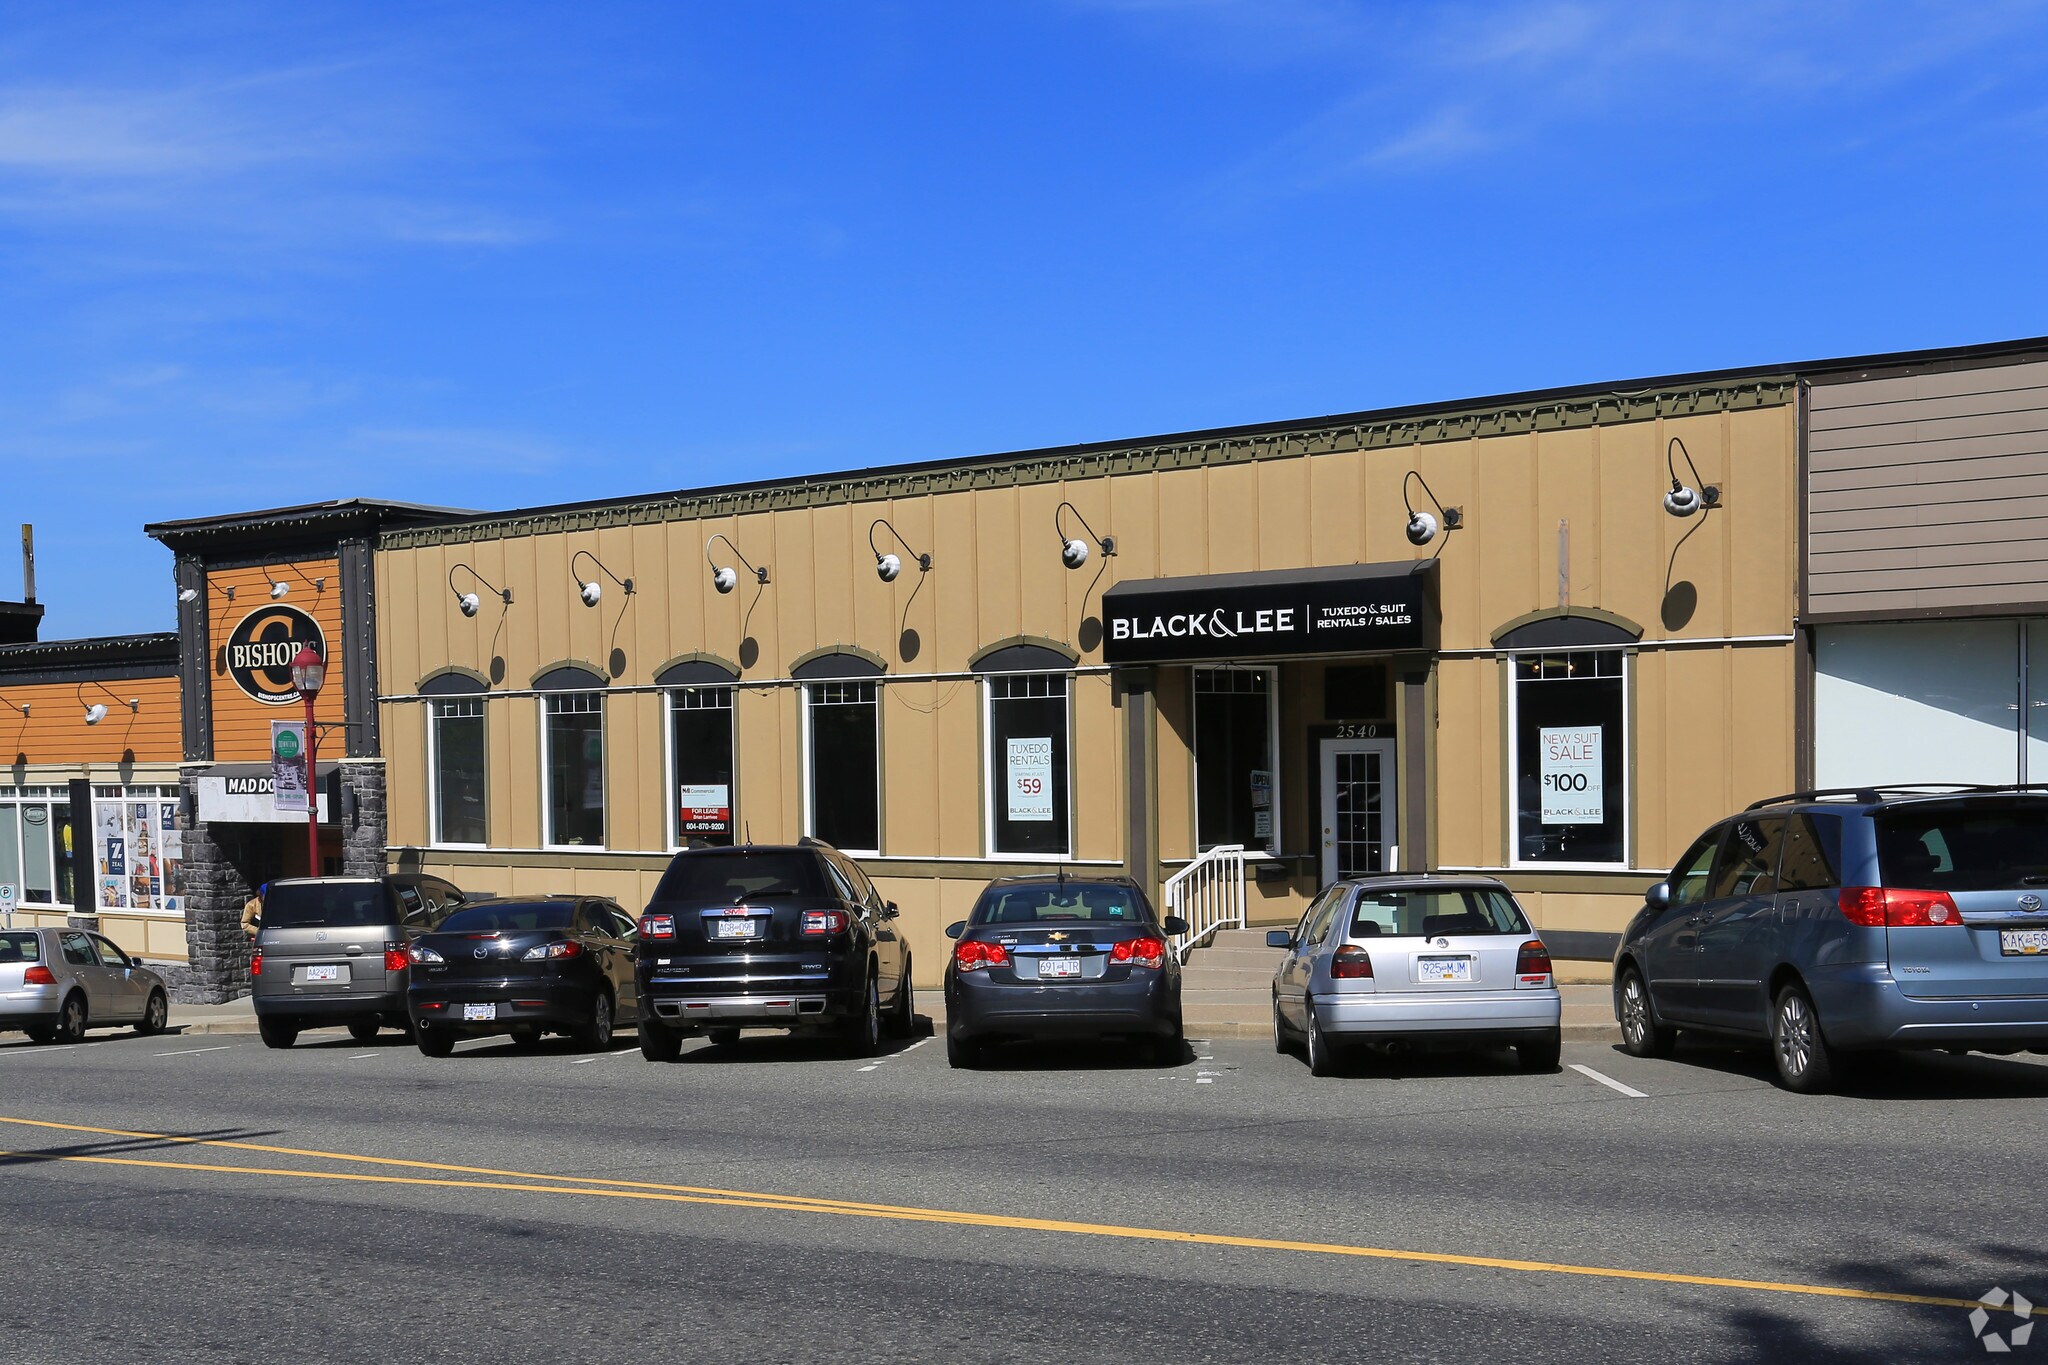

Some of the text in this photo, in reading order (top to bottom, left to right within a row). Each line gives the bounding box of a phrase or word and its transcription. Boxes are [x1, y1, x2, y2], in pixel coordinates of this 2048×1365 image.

[1322, 605, 1368, 617] TUXEDO
[1380, 603, 1406, 613] SUIT
[1317, 617, 1366, 629] RENTALS
[1375, 615, 1412, 625] SALES
[1336, 725, 1377, 738] 2540
[1543, 732, 1599, 745] NEW SUIT
[1010, 743, 1049, 754] TUXEDO
[1549, 744, 1594, 761] SALE
[1009, 755, 1050, 765] RENTALS
[228, 778, 257, 793] MAD
[1016, 778, 1042, 794] $59
[1253, 774, 1270, 785] OPEN
[1543, 773, 1588, 792] $100
[686, 822, 725, 830] 604-870-9200
[1902, 966, 1931, 974] TOYOTA
